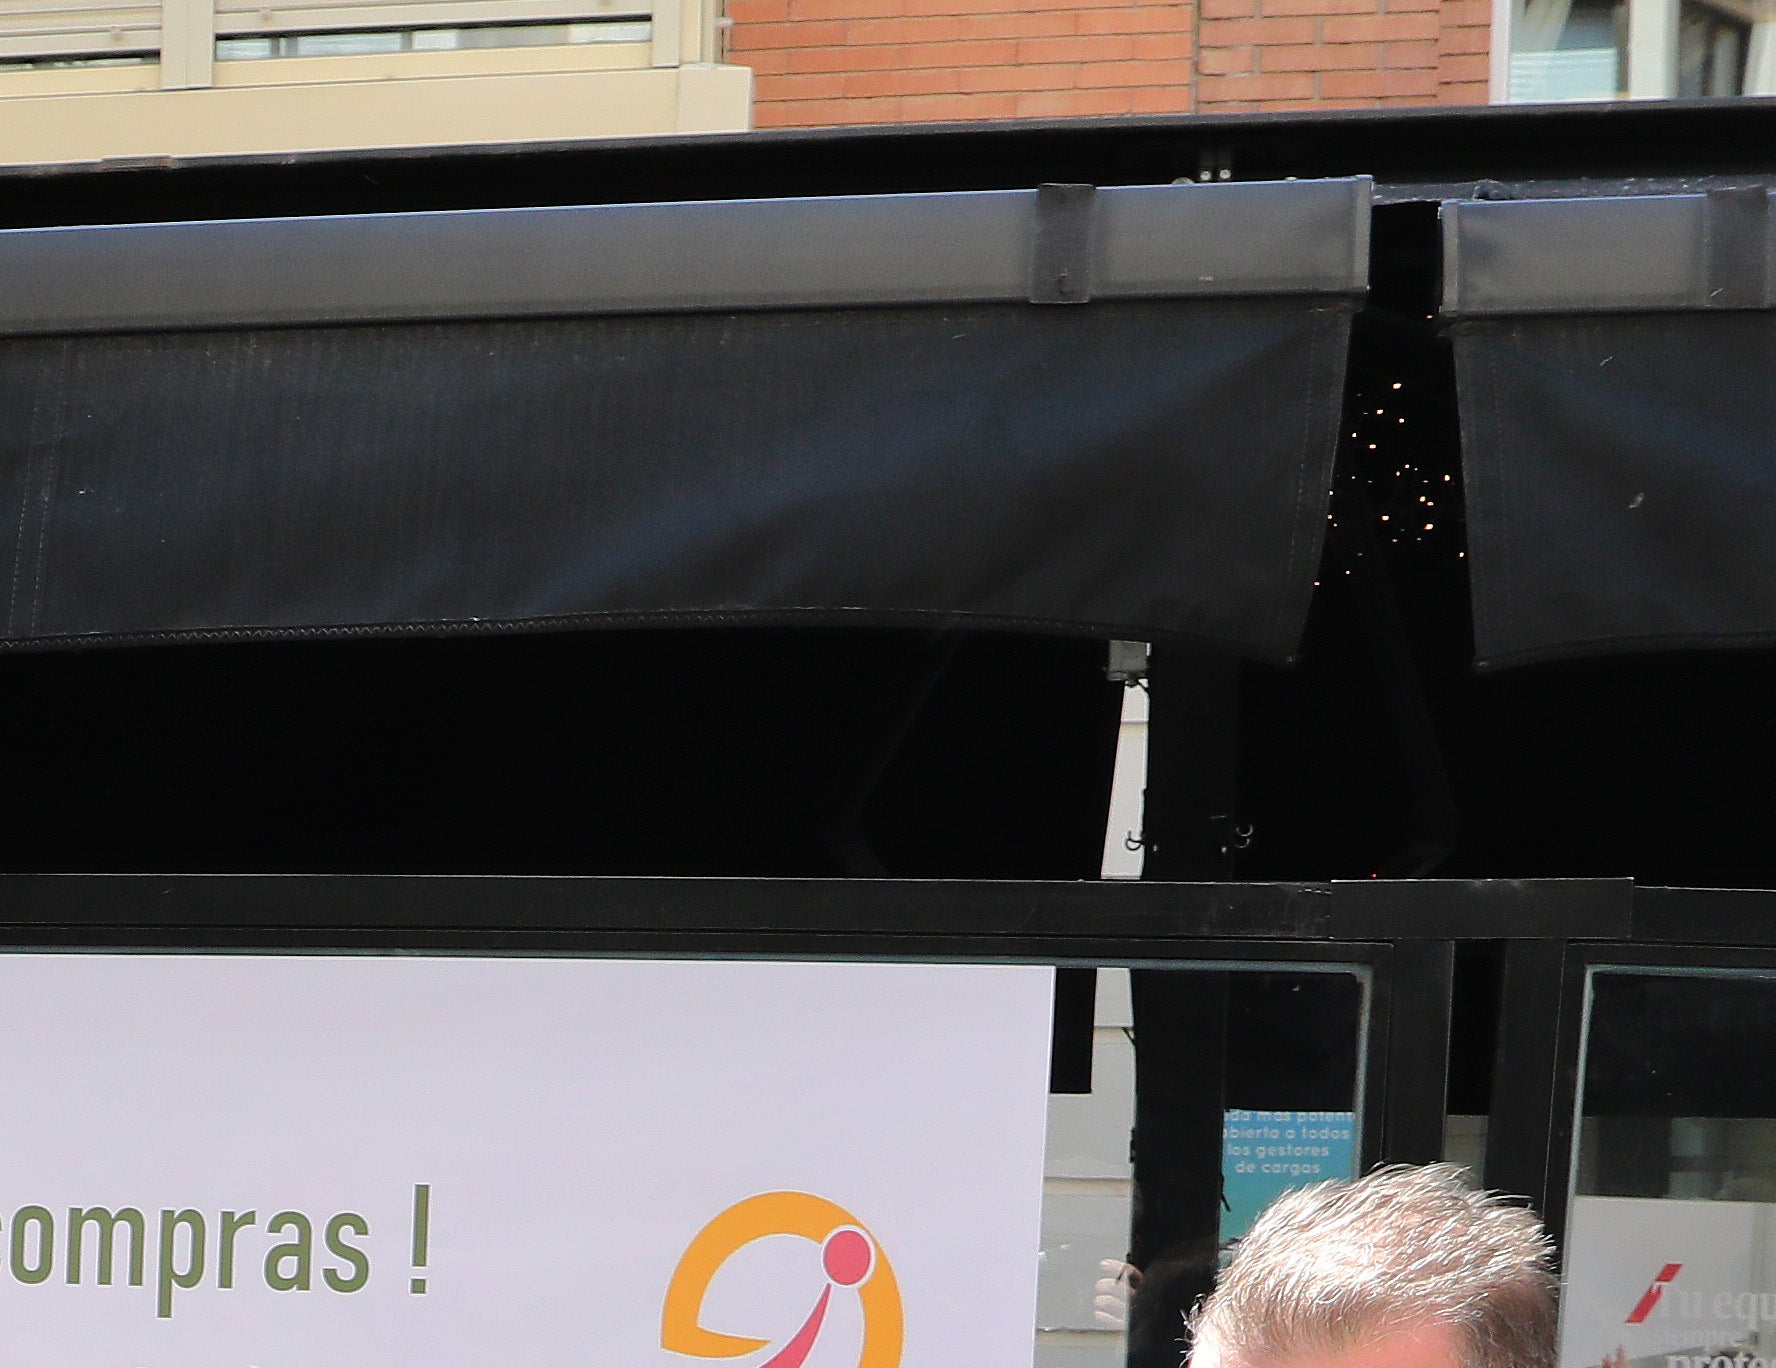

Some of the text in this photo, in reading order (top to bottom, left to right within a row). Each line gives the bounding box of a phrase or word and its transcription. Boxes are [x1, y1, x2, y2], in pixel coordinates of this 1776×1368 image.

[1256, 1144, 1330, 1159] gestores
[1235, 1160, 1321, 1176] de cargas
